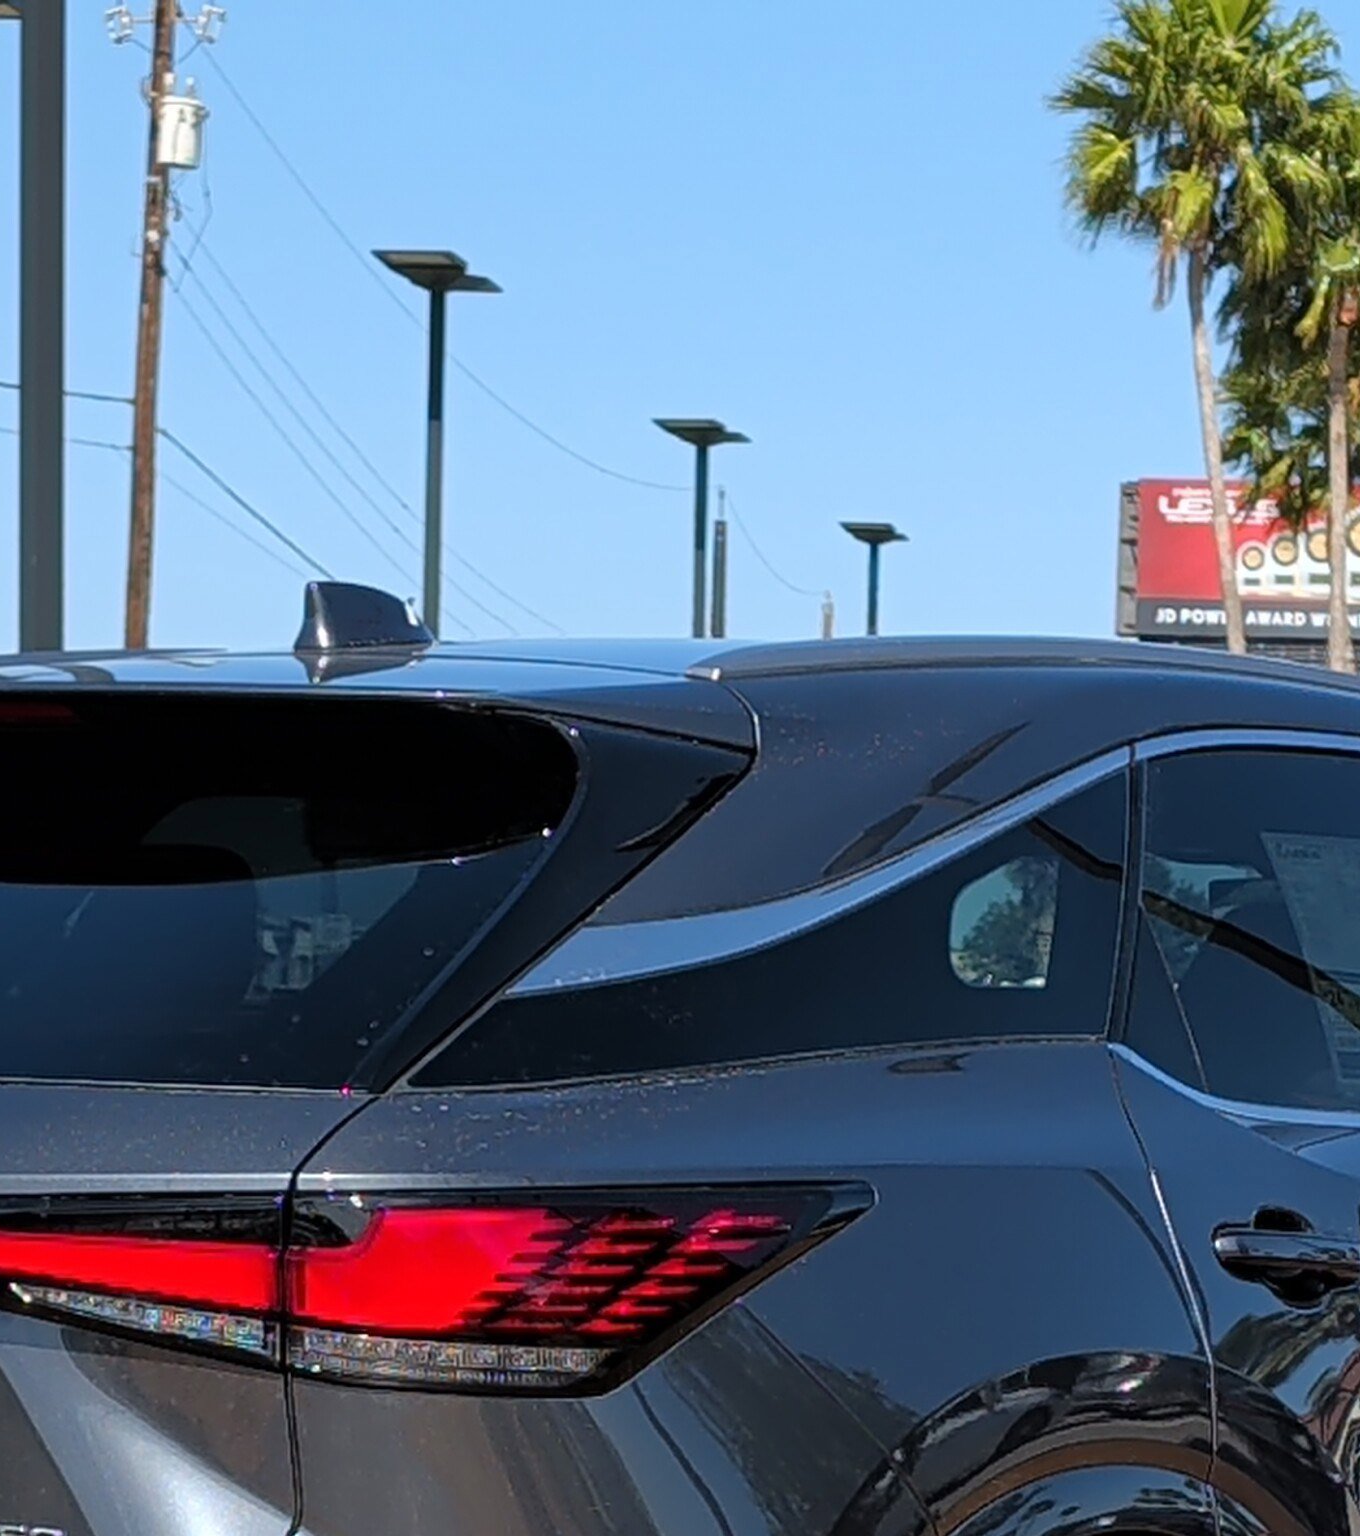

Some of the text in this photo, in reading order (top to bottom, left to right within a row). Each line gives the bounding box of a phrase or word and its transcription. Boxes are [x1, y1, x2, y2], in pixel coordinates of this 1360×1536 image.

[1159, 495, 1281, 518] LES
[1155, 607, 1177, 624] JD
[1180, 607, 1227, 625] POW
[1245, 610, 1307, 627] AWARD
